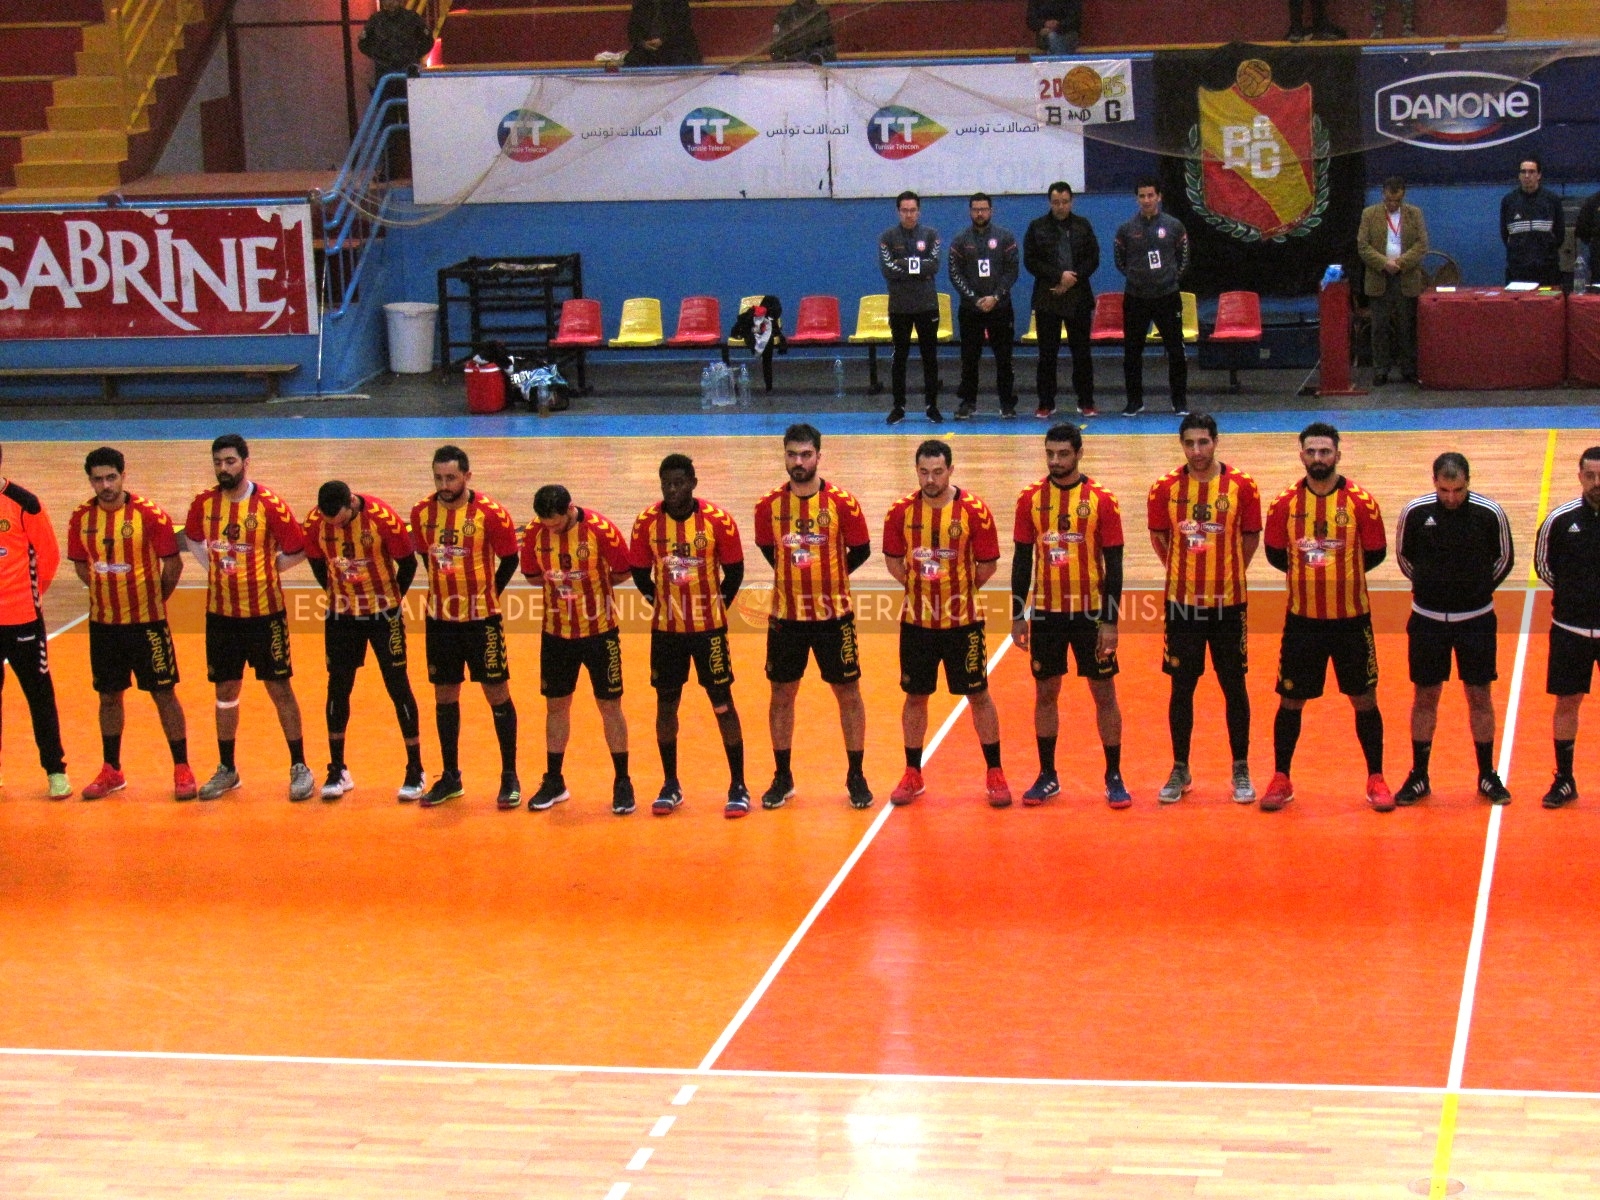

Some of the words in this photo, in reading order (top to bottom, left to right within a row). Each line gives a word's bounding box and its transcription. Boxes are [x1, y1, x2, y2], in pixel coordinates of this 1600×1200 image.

[1068, 108, 1092, 122] AND
[1105, 99, 1121, 122] G
[504, 120, 545, 146] TT
[581, 127, 614, 139] تونس
[687, 118, 730, 145] TT
[766, 124, 800, 137] تونس
[803, 123, 849, 135] اتصالات
[874, 116, 918, 143] TT
[955, 123, 990, 136] تونس
[910, 258, 919, 270] D
[1150, 254, 1159, 265] B
[980, 262, 988, 273] C
[103, 538, 115, 560] 7
[793, 552, 811, 564] TT
[1050, 550, 1066, 562] TT
[1307, 551, 1325, 563] TT
[671, 569, 688, 580] TT
[923, 563, 940, 575] TT
